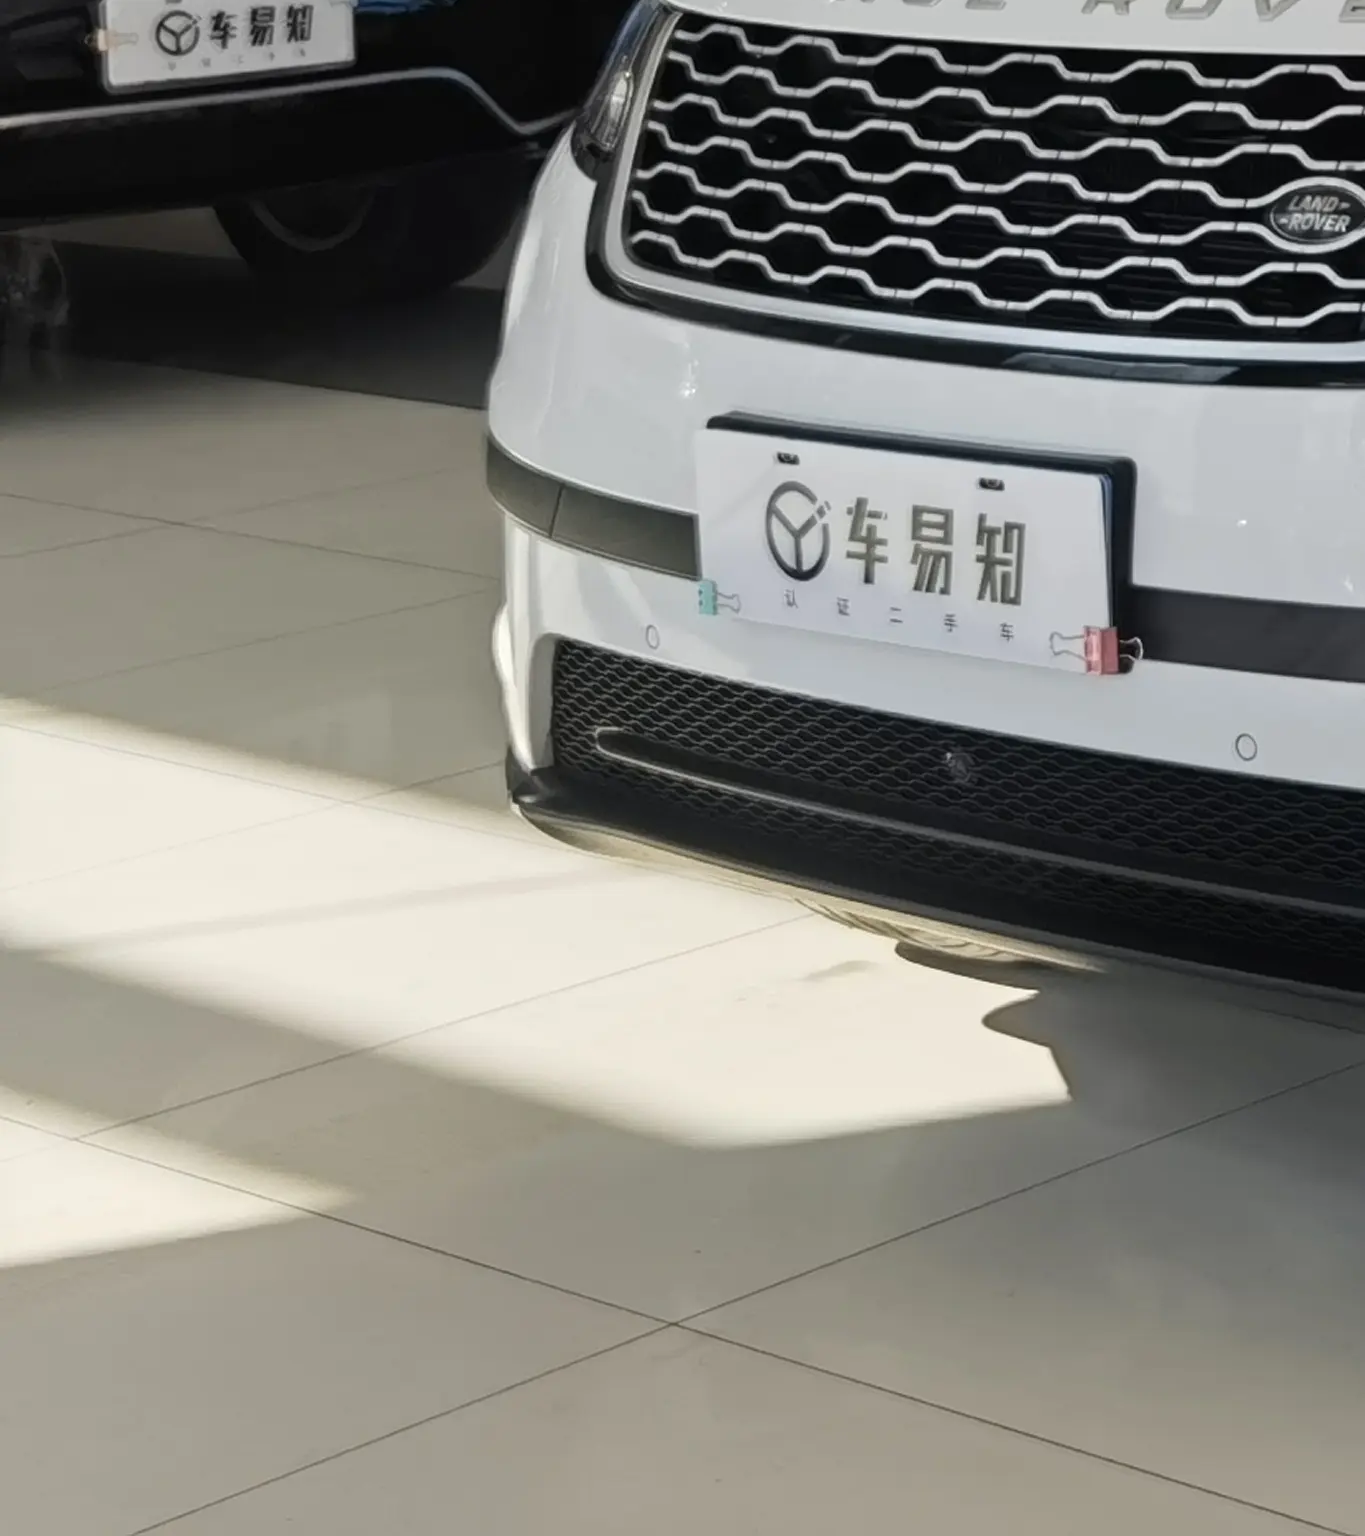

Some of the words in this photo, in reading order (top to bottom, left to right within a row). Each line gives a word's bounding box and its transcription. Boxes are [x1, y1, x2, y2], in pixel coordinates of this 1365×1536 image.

[209, 4, 314, 50] 车易知
[846, 496, 1026, 606] 车易知
